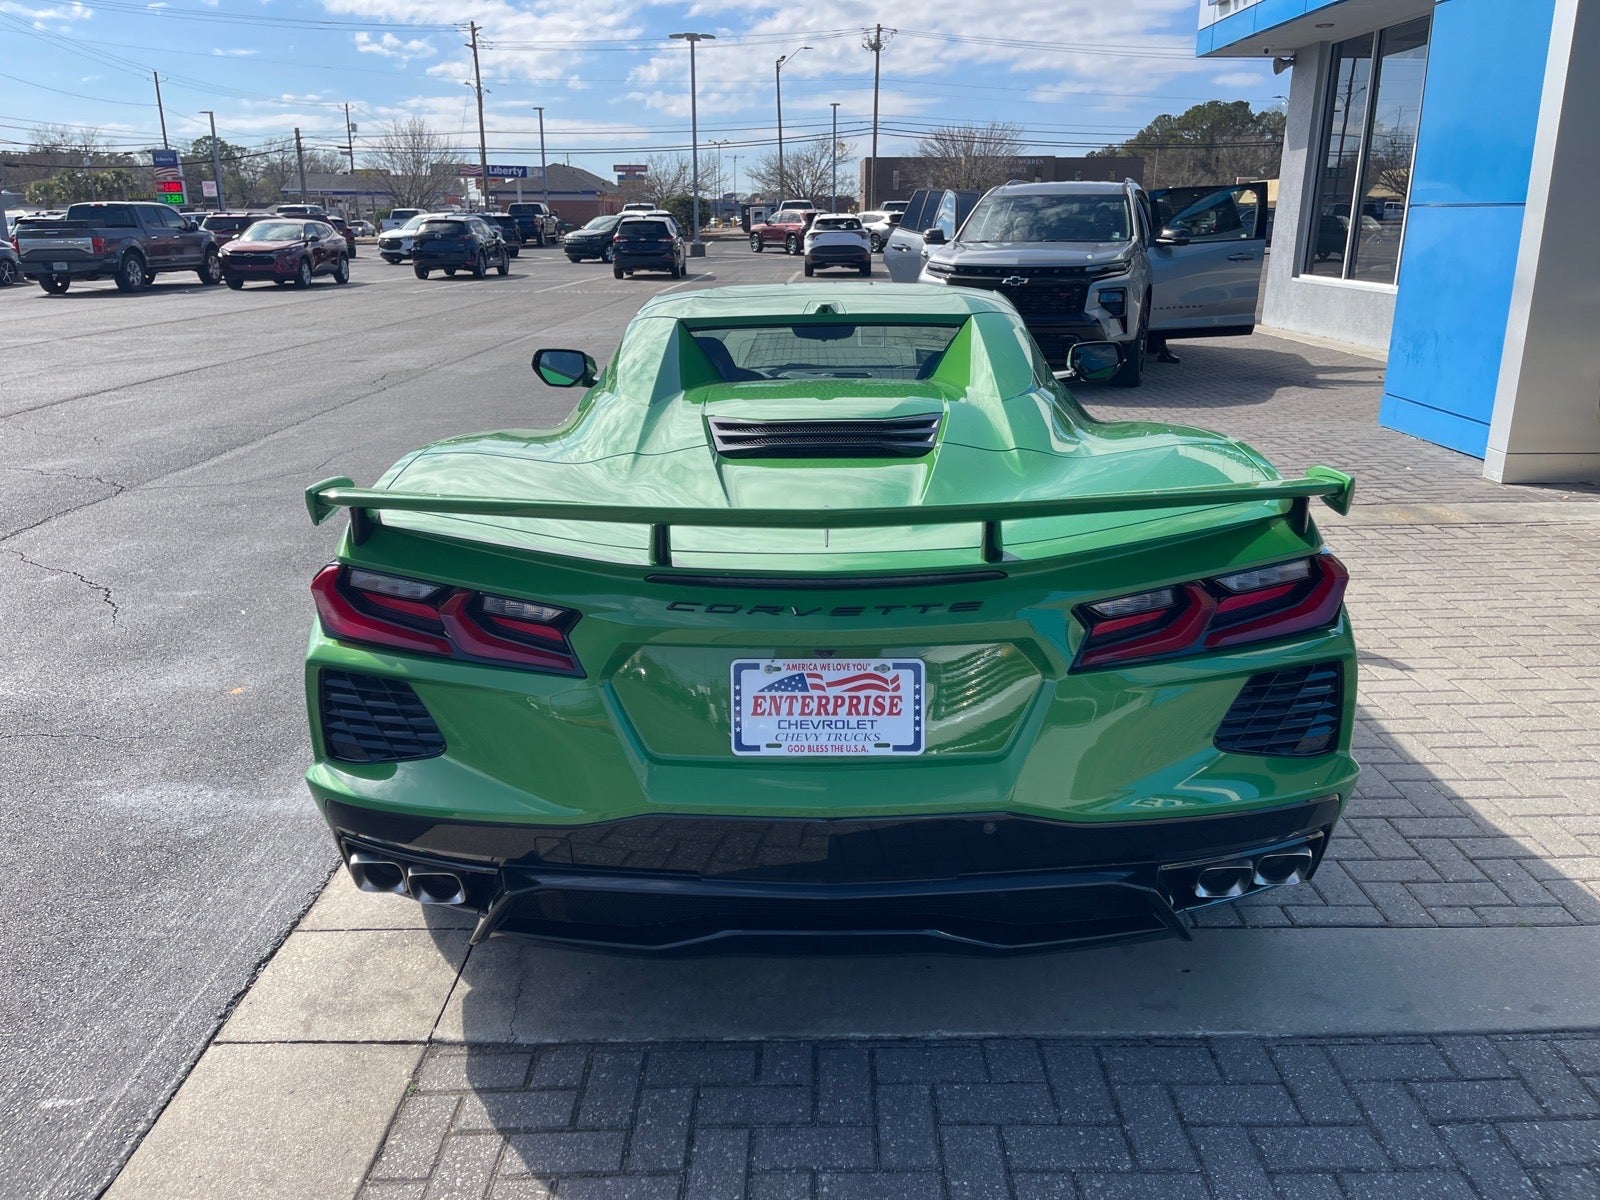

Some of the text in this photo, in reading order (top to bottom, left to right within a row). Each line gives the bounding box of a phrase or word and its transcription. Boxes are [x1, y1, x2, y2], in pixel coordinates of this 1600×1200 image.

[488, 166, 523, 177] Liberty
[665, 600, 985, 617] CORVETTE
[783, 662, 871, 671] "AMERICA WE LOVE YOU"
[750, 695, 904, 717] ENTERPRISE
[777, 719, 878, 730] CHEVROLET
[774, 732, 881, 742] CHEVY TRUCKS
[787, 744, 869, 753] GOD BLESS THE U.S.A.
